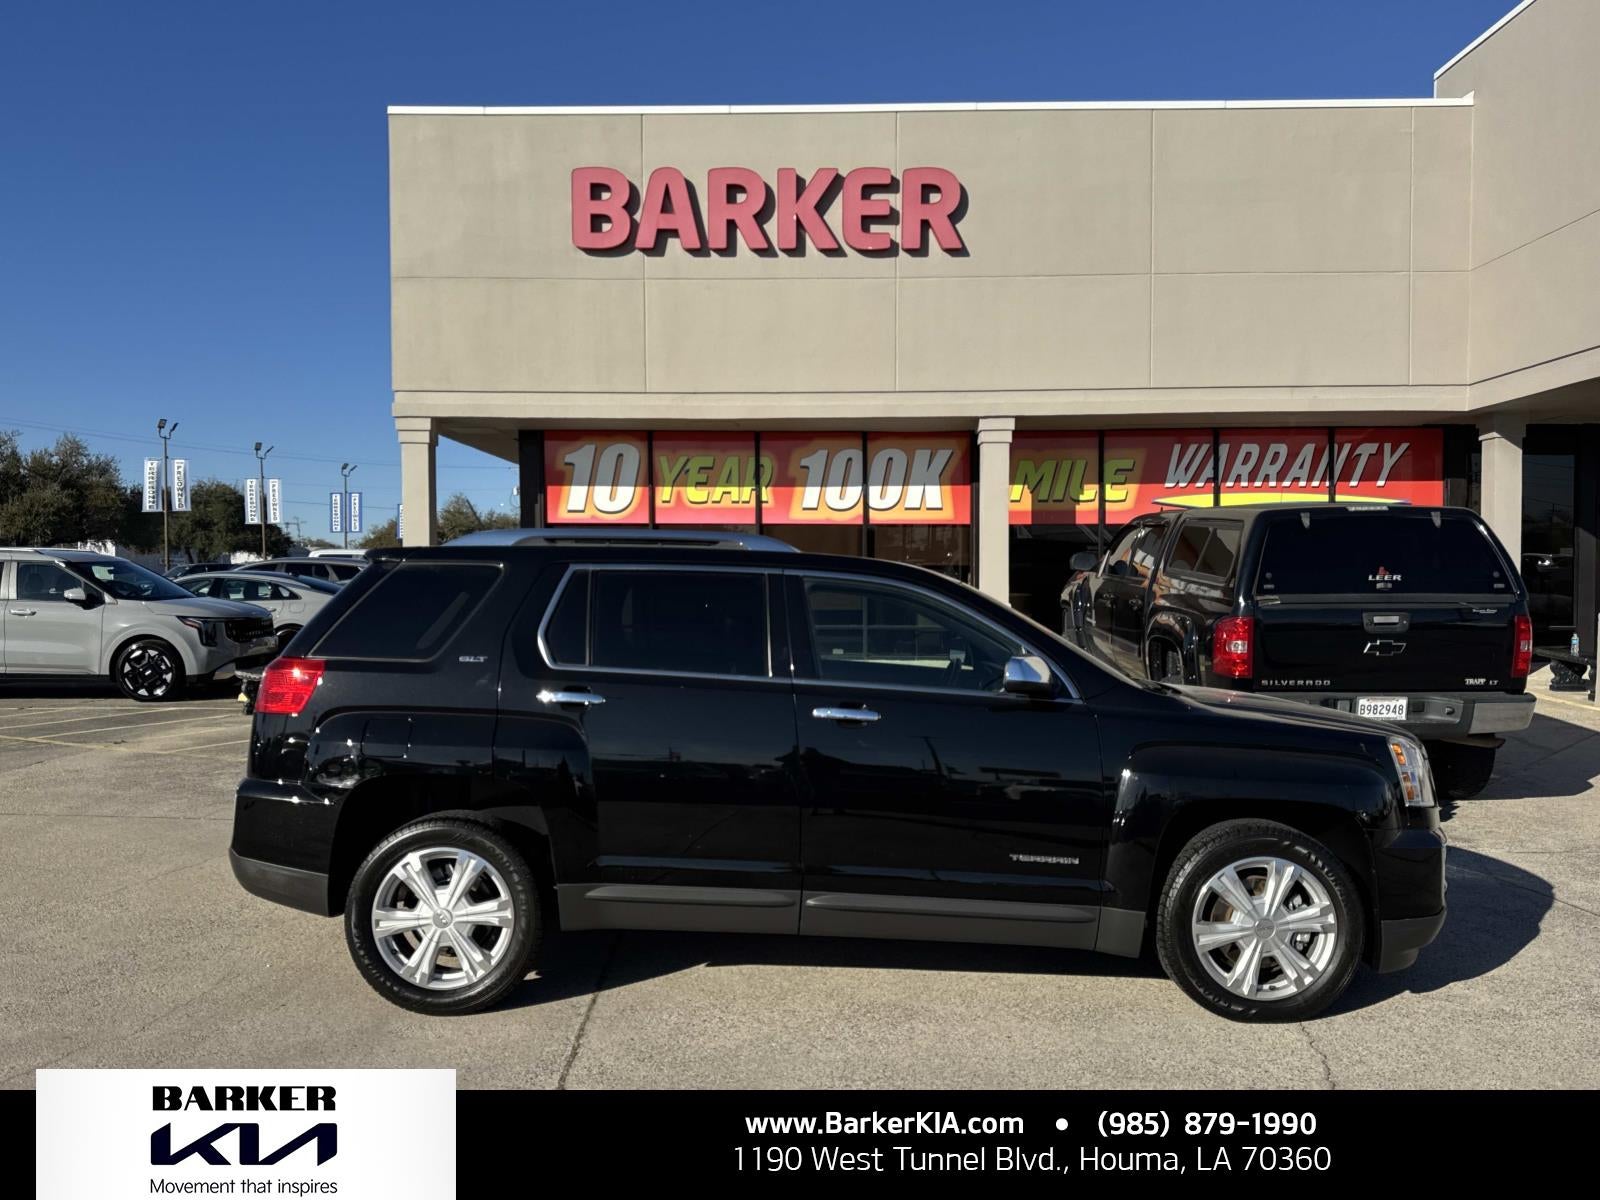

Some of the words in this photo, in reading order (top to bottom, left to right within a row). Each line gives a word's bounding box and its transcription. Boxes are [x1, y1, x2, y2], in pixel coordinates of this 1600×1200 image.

[571, 166, 964, 253] BARKER
[563, 442, 641, 514] 10
[659, 455, 774, 504] YEAR
[799, 448, 954, 511] 100K
[1010, 459, 1136, 502] MILE
[1164, 442, 1410, 488] WARRANTY
[1261, 679, 1331, 687] SILVERADO
[1359, 704, 1404, 716] B982948
[1008, 853, 1080, 865] TERRAIN
